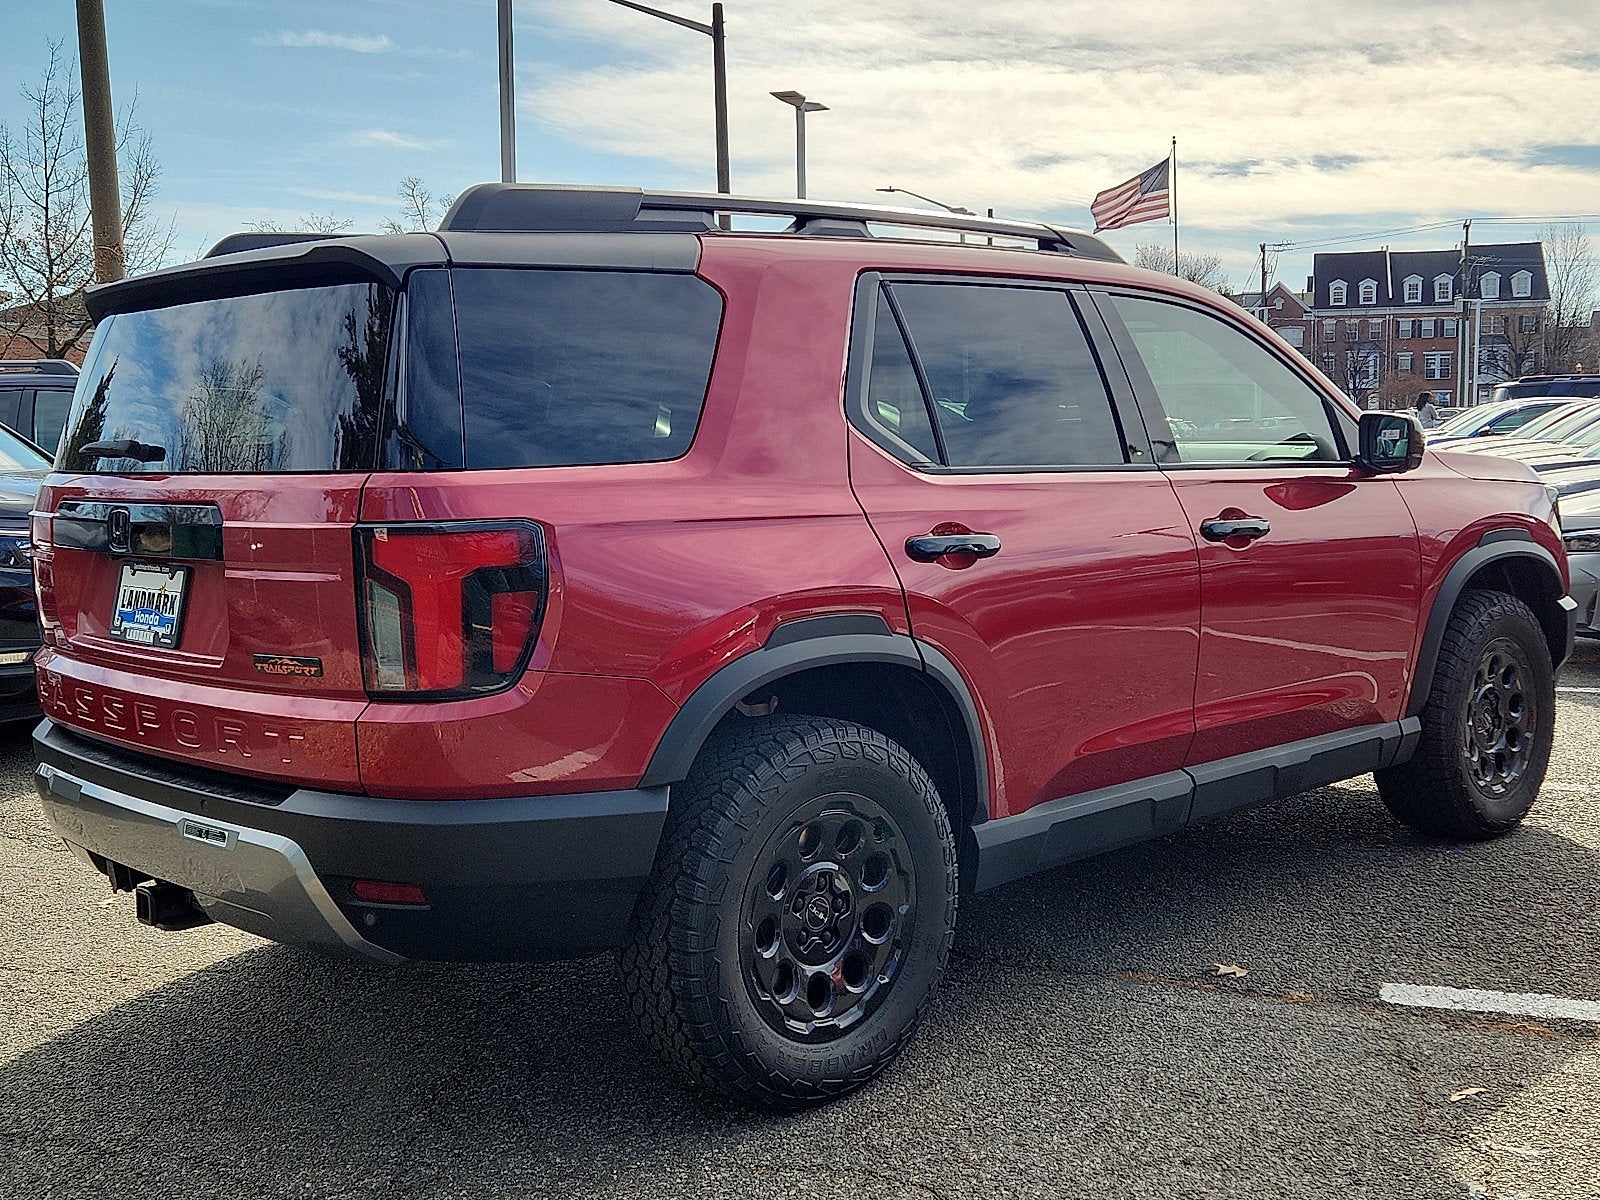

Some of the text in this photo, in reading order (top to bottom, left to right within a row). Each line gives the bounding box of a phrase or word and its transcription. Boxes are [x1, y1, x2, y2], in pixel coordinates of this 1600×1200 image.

[120, 587, 178, 617] LANDMARK
[134, 610, 159, 626] Honda
[254, 662, 319, 677] TRAILSPORT
[39, 680, 305, 764] PASSPORT
